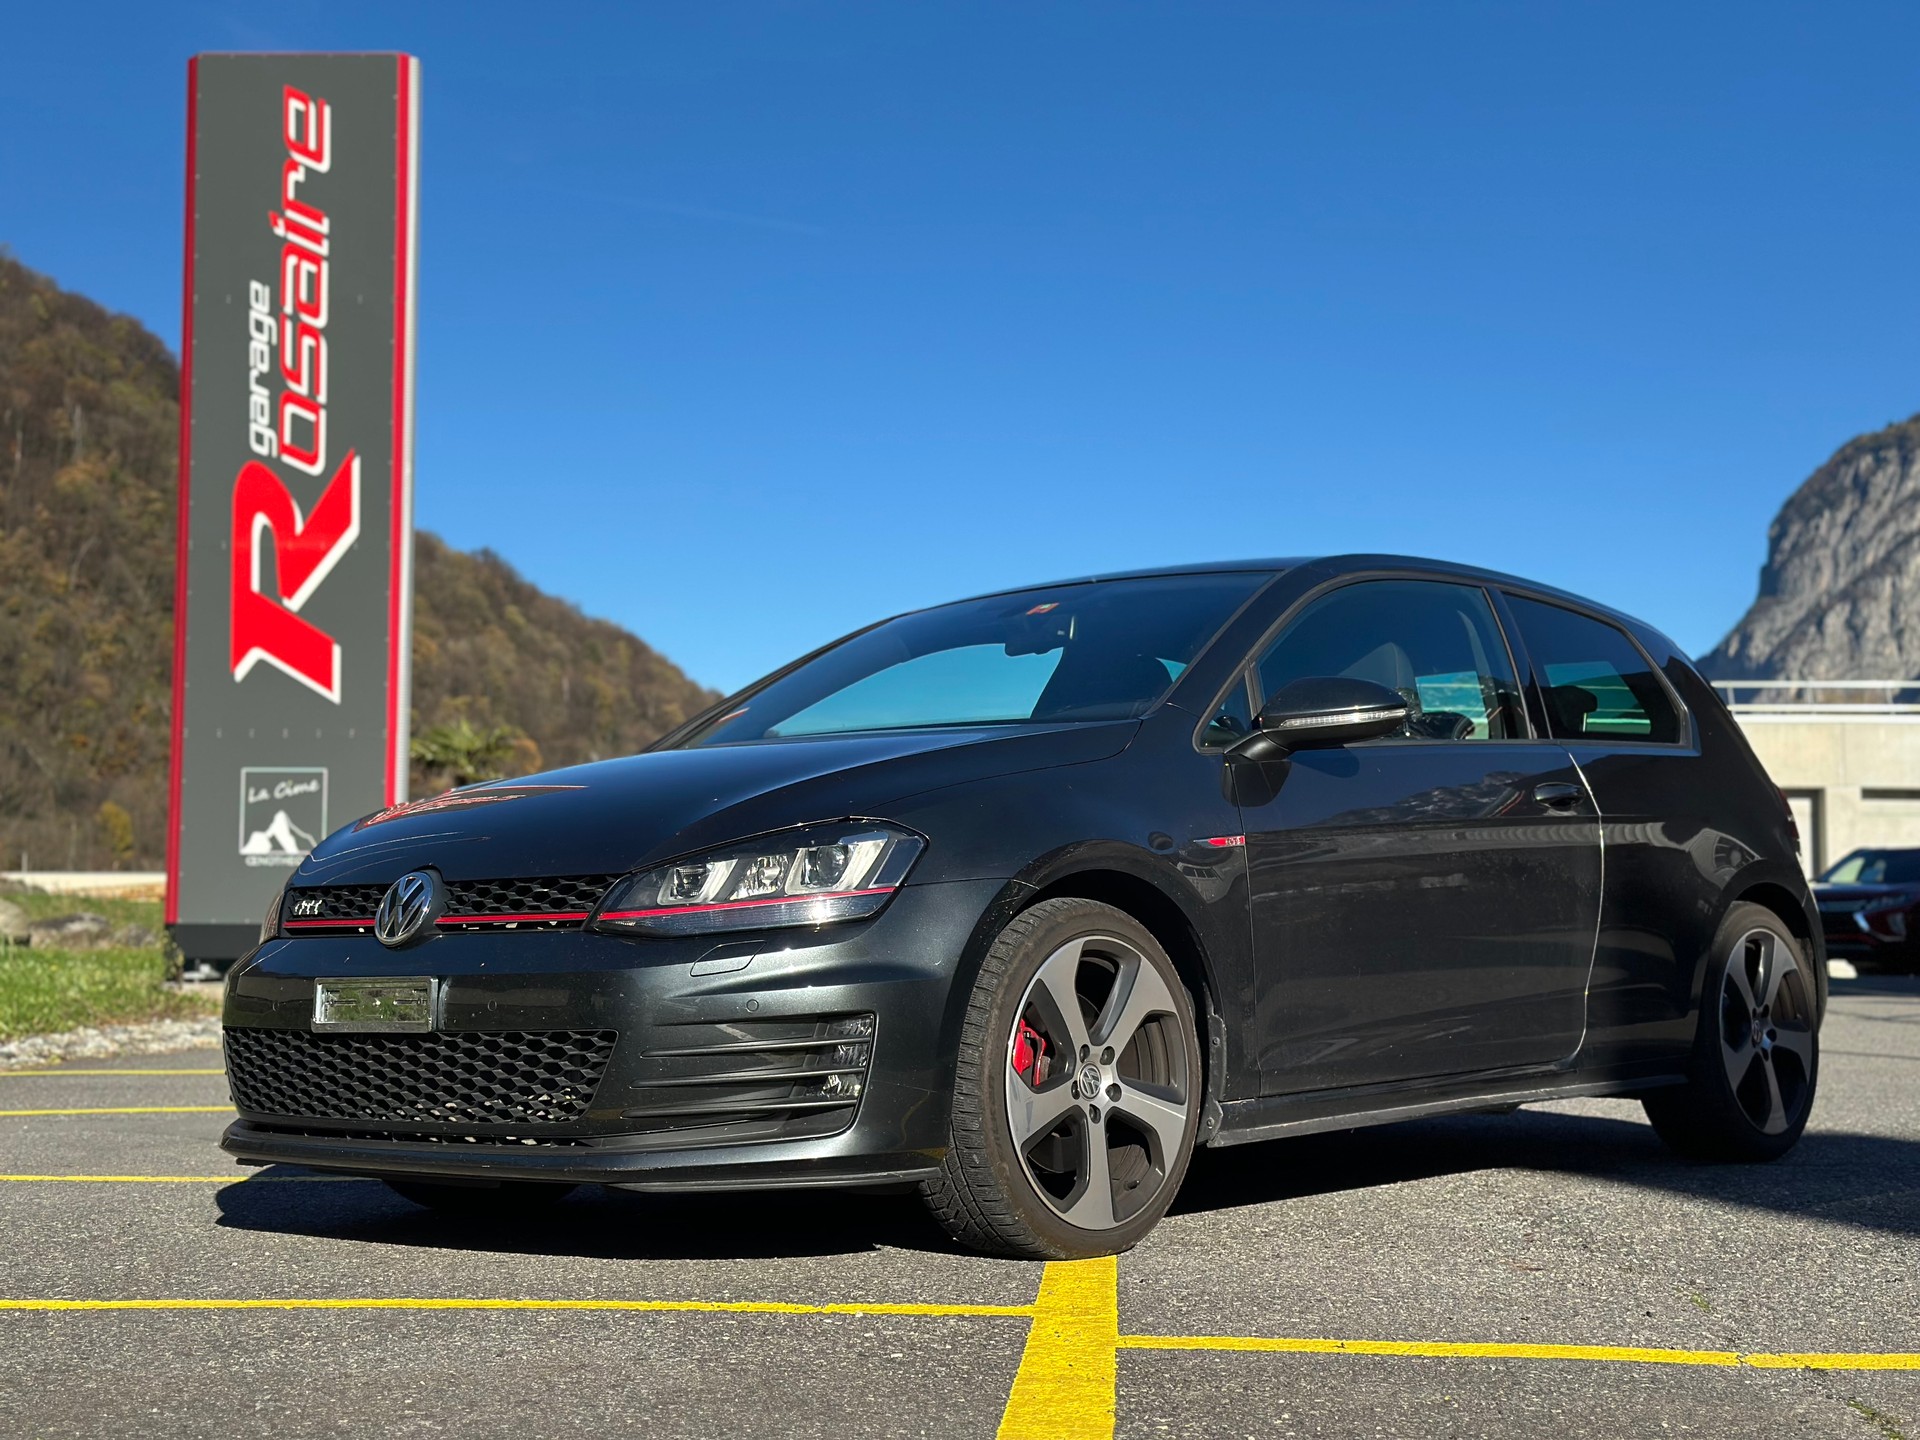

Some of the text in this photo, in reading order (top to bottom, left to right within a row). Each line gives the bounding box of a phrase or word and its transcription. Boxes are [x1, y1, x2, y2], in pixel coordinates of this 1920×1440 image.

[230, 84, 360, 705] Rosaire
[249, 280, 277, 457] garage
[248, 787, 270, 804] La
